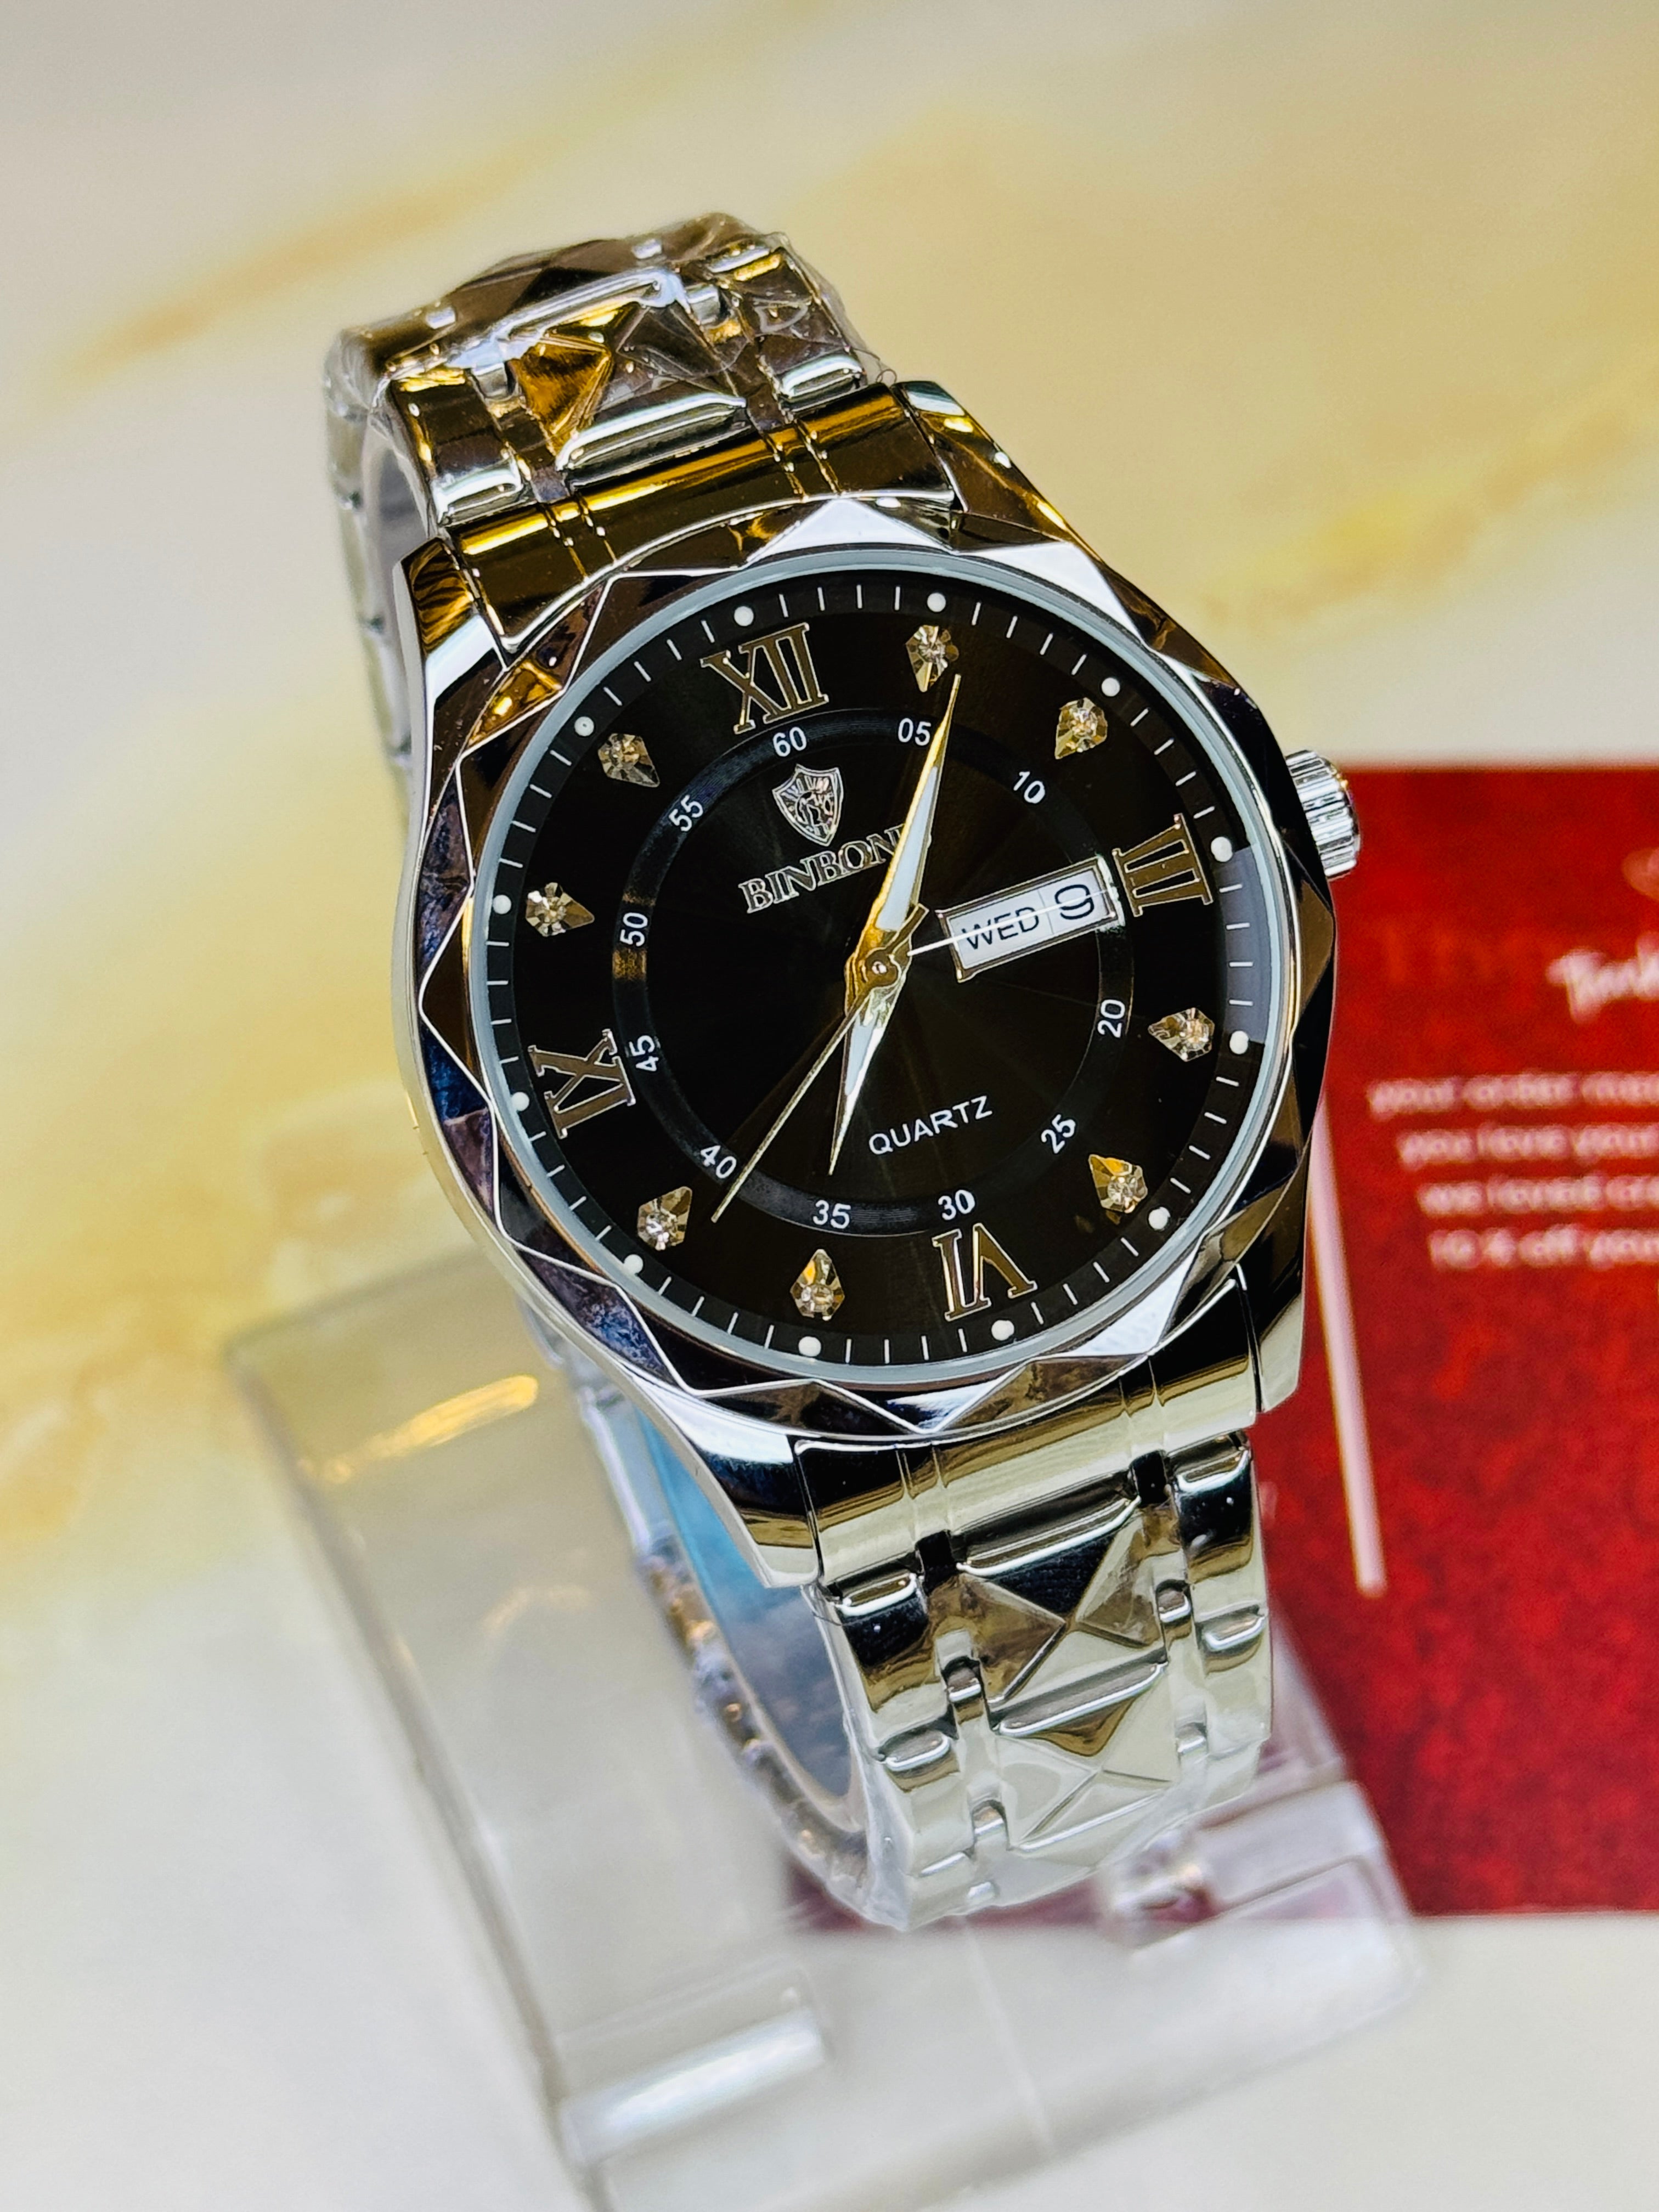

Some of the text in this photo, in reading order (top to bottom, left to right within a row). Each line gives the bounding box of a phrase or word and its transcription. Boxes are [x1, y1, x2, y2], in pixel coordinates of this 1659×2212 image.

[699, 622, 830, 735] XII
[772, 726, 807, 757] 60
[898, 718, 932, 746] 05
[1013, 771, 1046, 804] 10
[668, 794, 703, 832] 55
[738, 823, 932, 914] BINBON
[1111, 812, 1214, 917] III
[619, 912, 648, 947] 50
[961, 884, 1094, 950] WED 9
[1097, 999, 1126, 1038] 20
[629, 1035, 659, 1071] 45
[868, 1096, 992, 1155] QUARTZ
[1041, 1114, 1076, 1154] 25
[700, 1145, 737, 1179] 40
[812, 1199, 851, 1229] 35
[938, 1189, 975, 1220] 30
